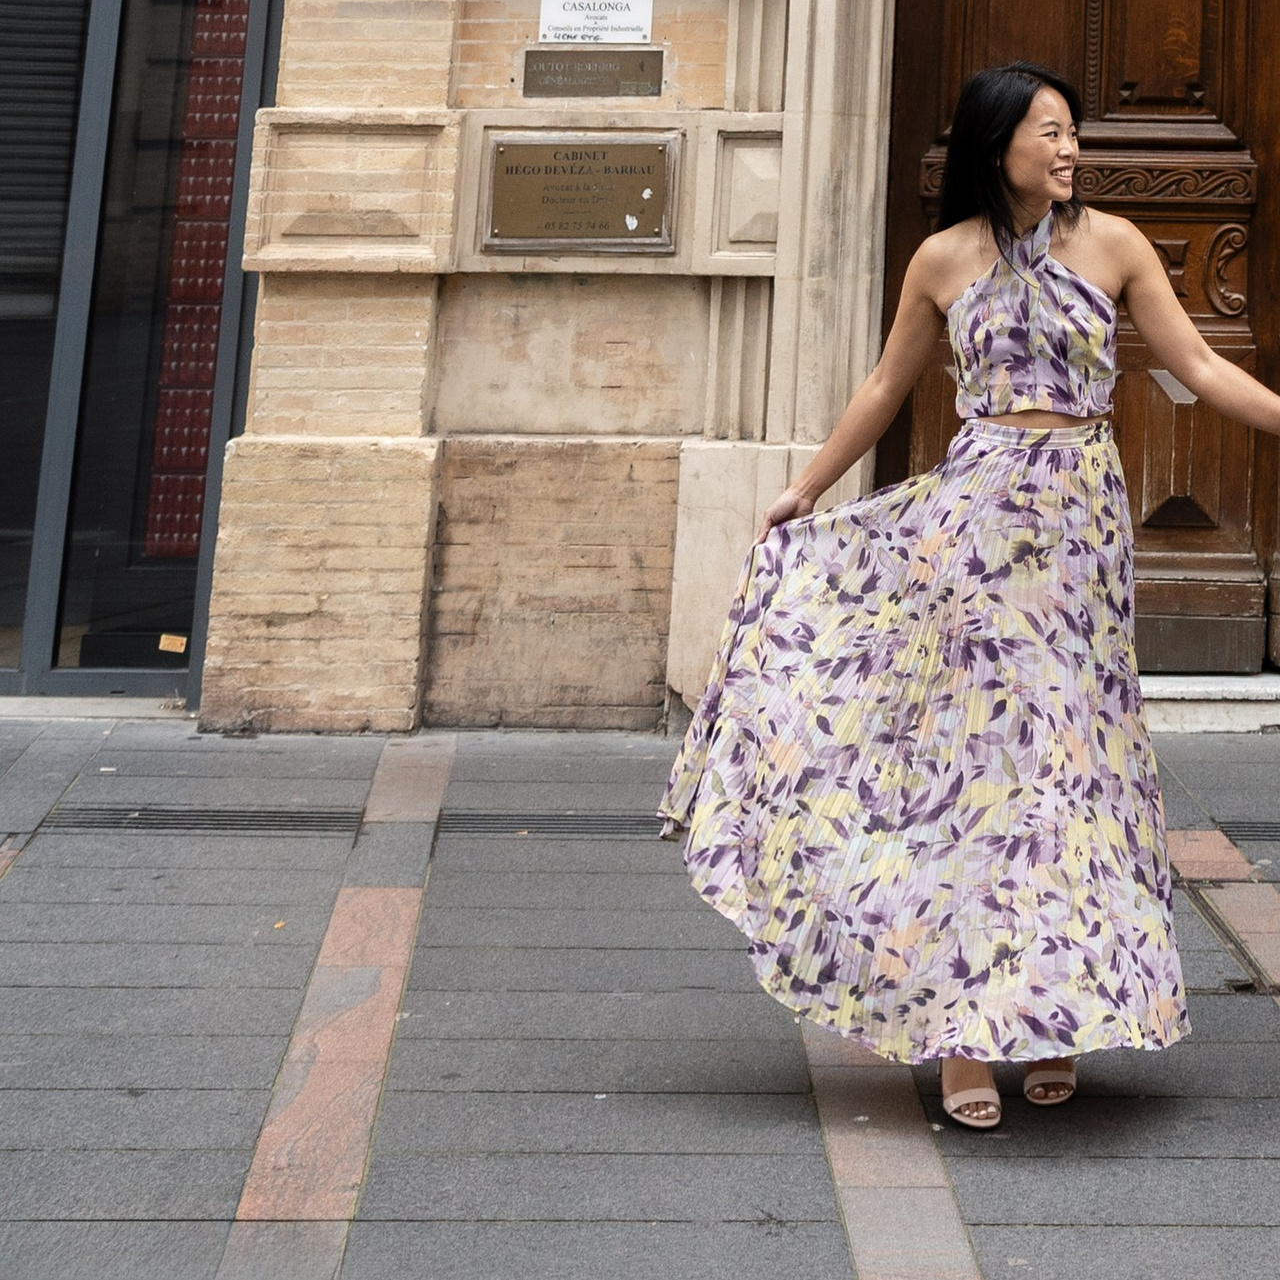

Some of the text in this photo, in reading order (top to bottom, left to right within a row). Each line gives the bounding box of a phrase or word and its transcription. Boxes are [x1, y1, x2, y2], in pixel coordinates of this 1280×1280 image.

[562, 1, 631, 12] CASALONGA
[582, 25, 610, 33] Propriété
[553, 151, 609, 161] CABINET
[603, 165, 655, 175] BARRAU
[544, 222, 556, 230] 05
[558, 222, 569, 230] 82
